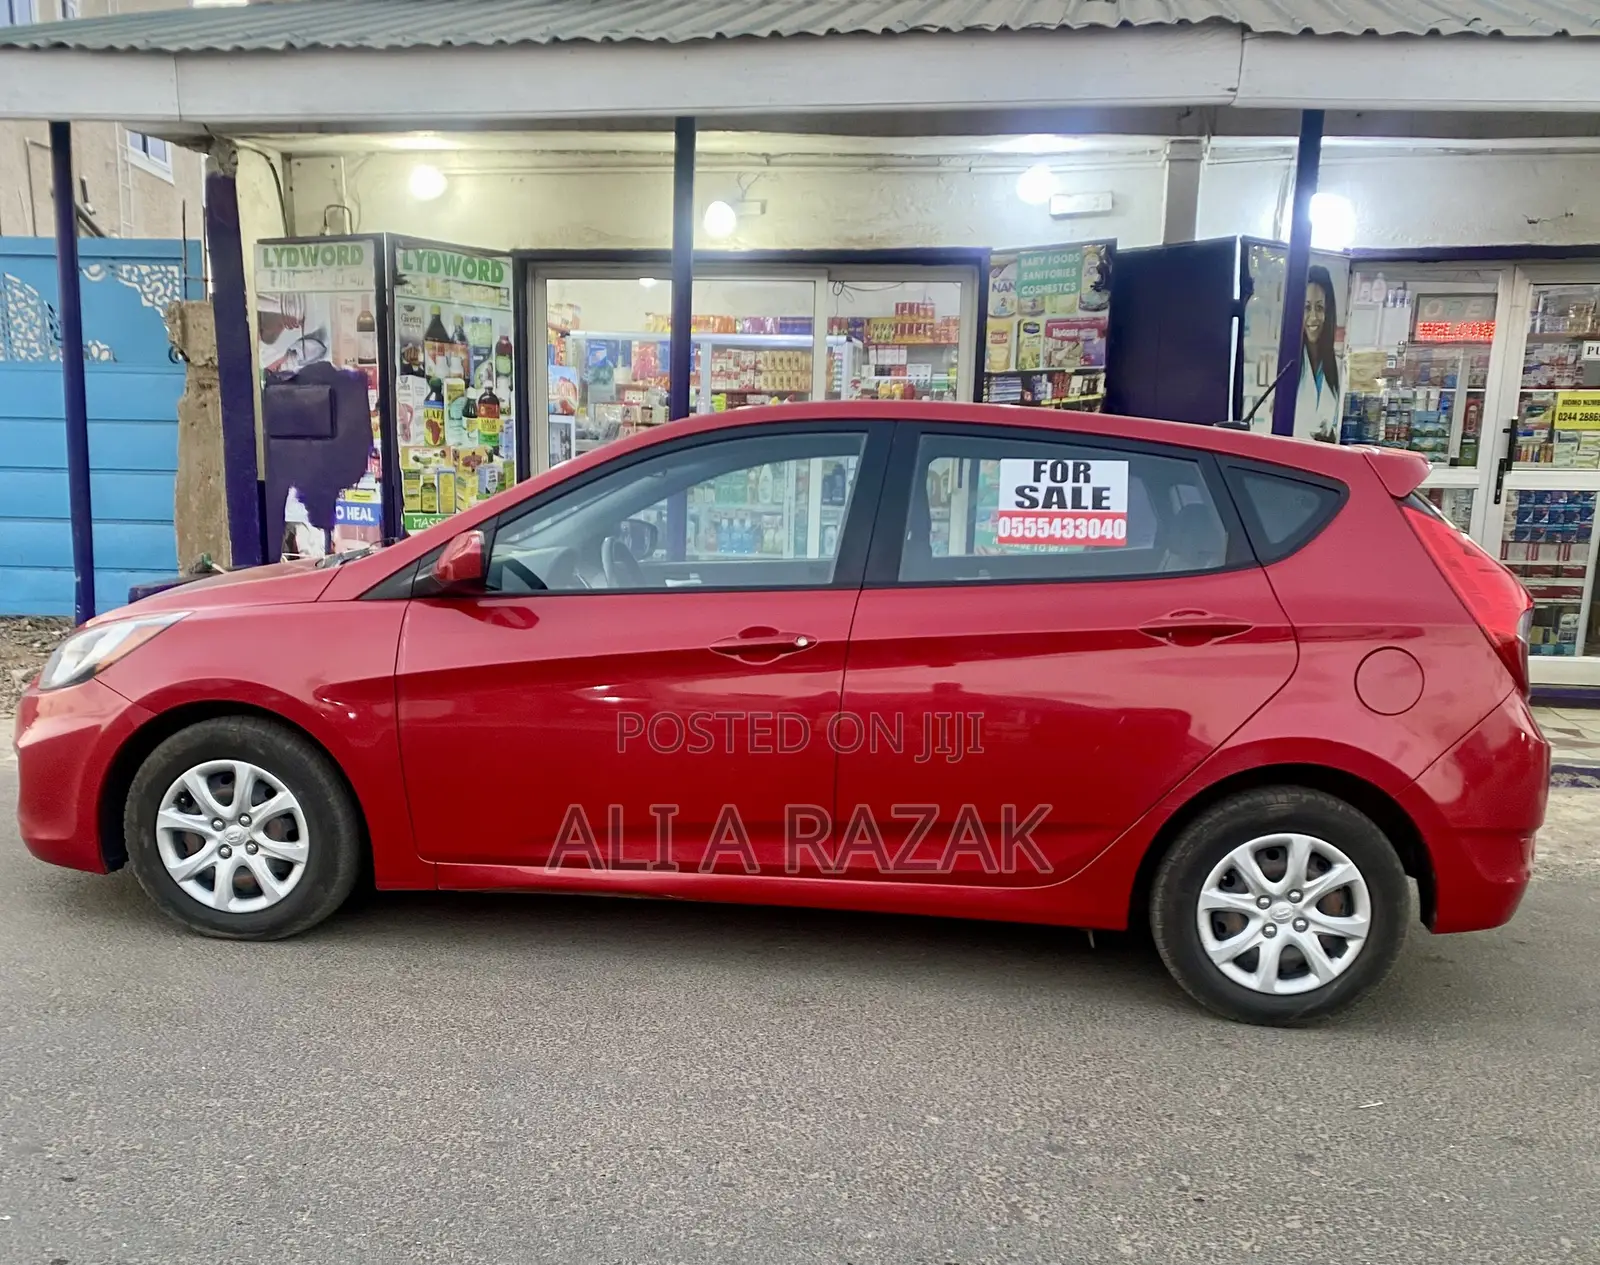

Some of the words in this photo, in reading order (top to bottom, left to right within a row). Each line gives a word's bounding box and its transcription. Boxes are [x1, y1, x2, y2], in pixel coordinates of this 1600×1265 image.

[263, 244, 364, 268] LYDWORD
[402, 249, 504, 283] LYDWORD
[1048, 252, 1080, 265] FOODS
[1558, 411, 1577, 422] 0244
[1579, 411, 1600, 422] 2886
[1033, 460, 1091, 484] FOR
[1015, 485, 1111, 510] SALE
[346, 506, 374, 522] HEAL
[999, 517, 1126, 540] 0555433040
